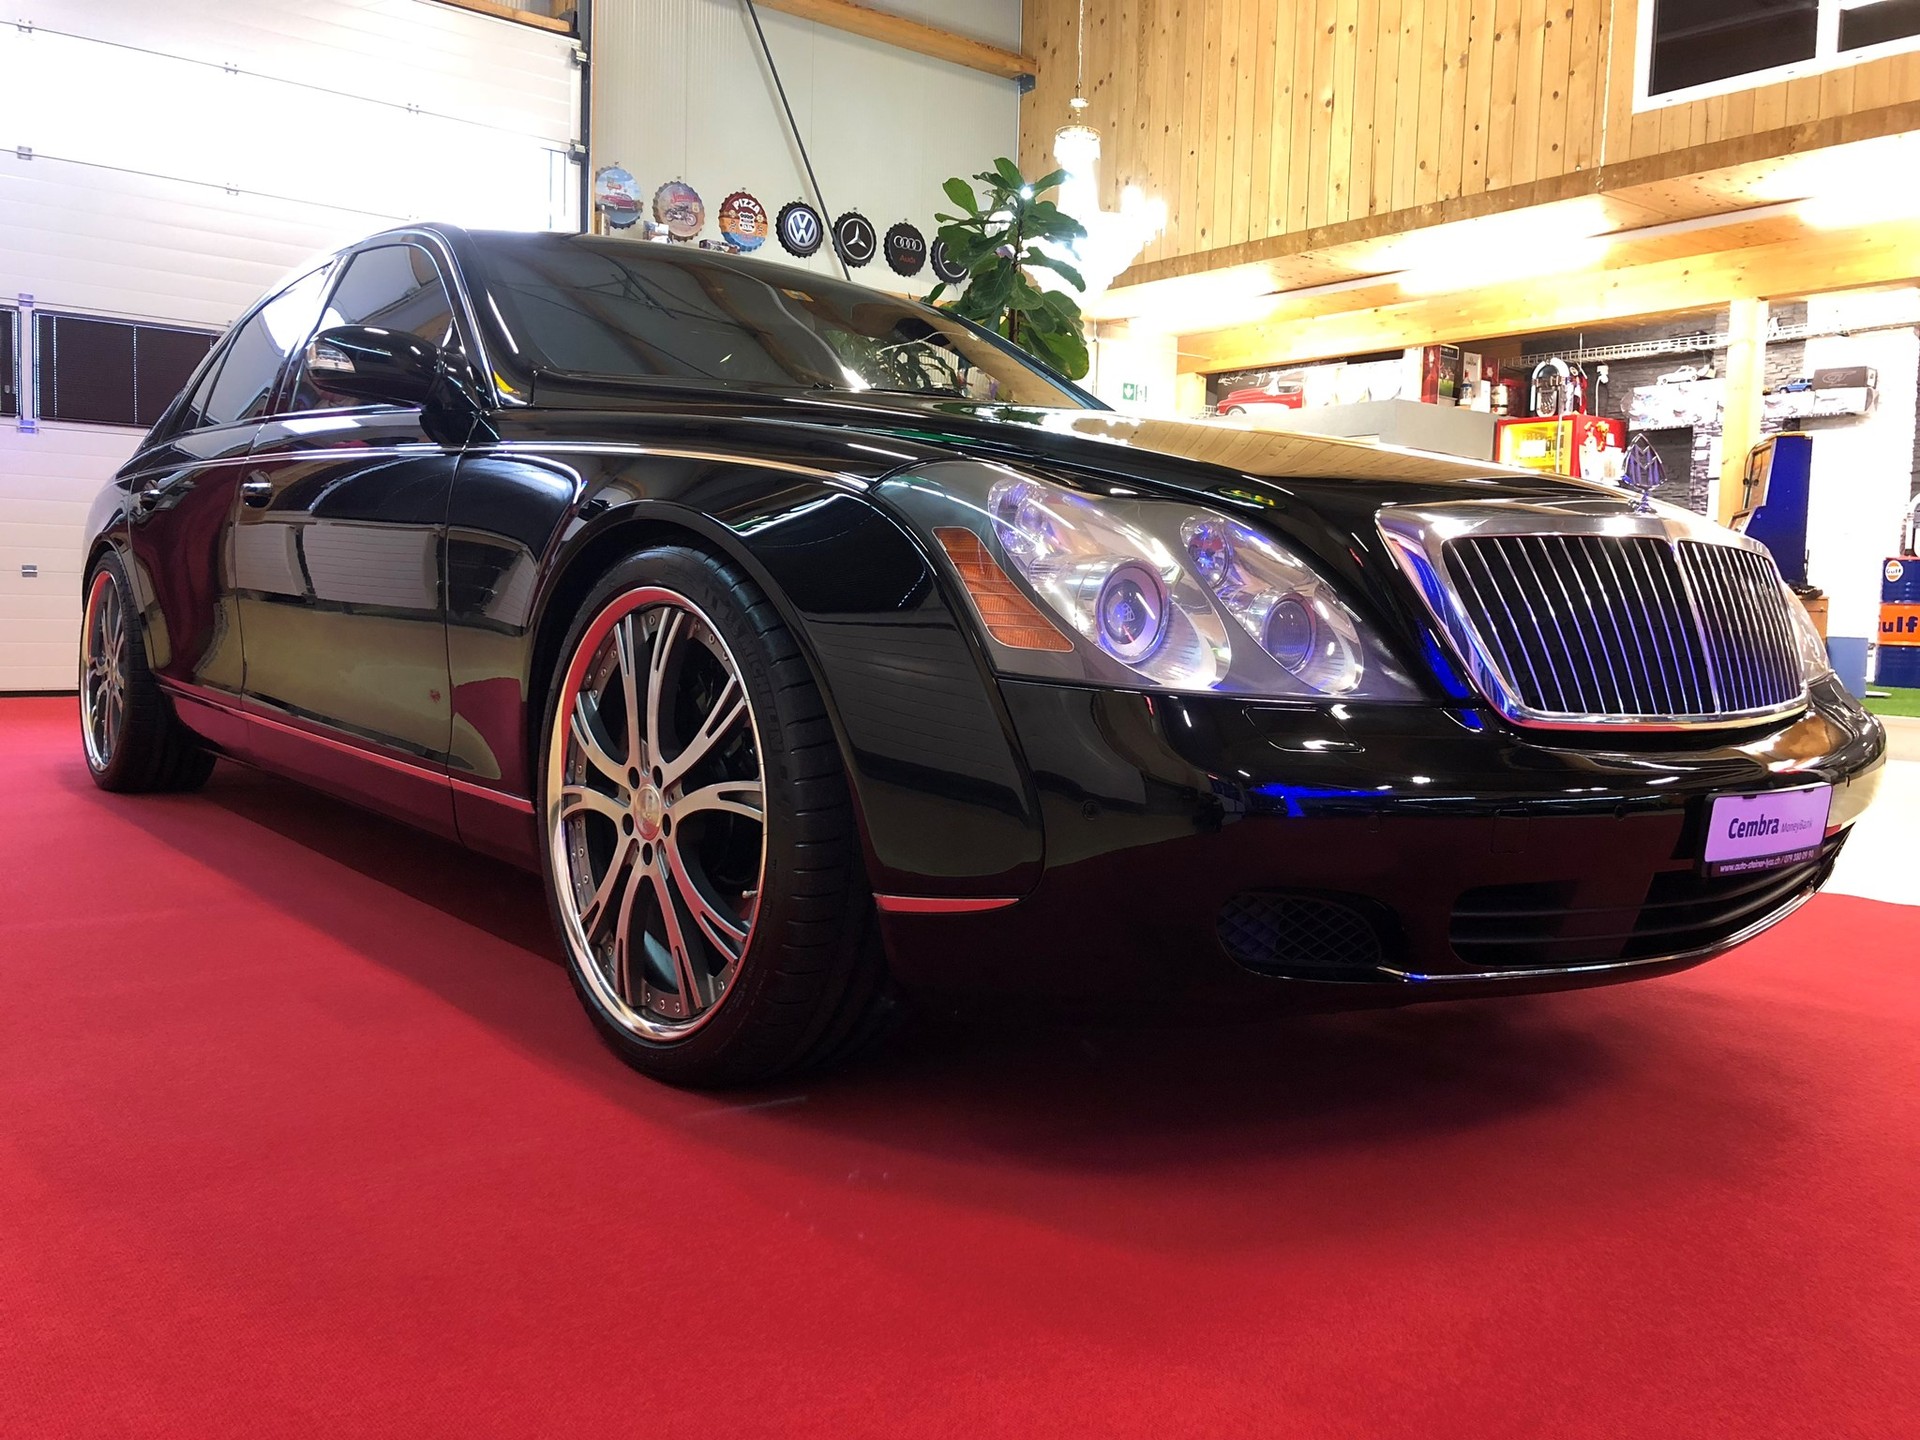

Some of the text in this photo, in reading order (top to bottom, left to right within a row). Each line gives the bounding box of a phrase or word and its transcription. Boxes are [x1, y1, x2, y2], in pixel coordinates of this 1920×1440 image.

[732, 198, 761, 214] PIZZA
[900, 254, 916, 264] Audi
[1878, 615, 1918, 633] ulf
[1728, 814, 1812, 839] Cembra MoneyBank
